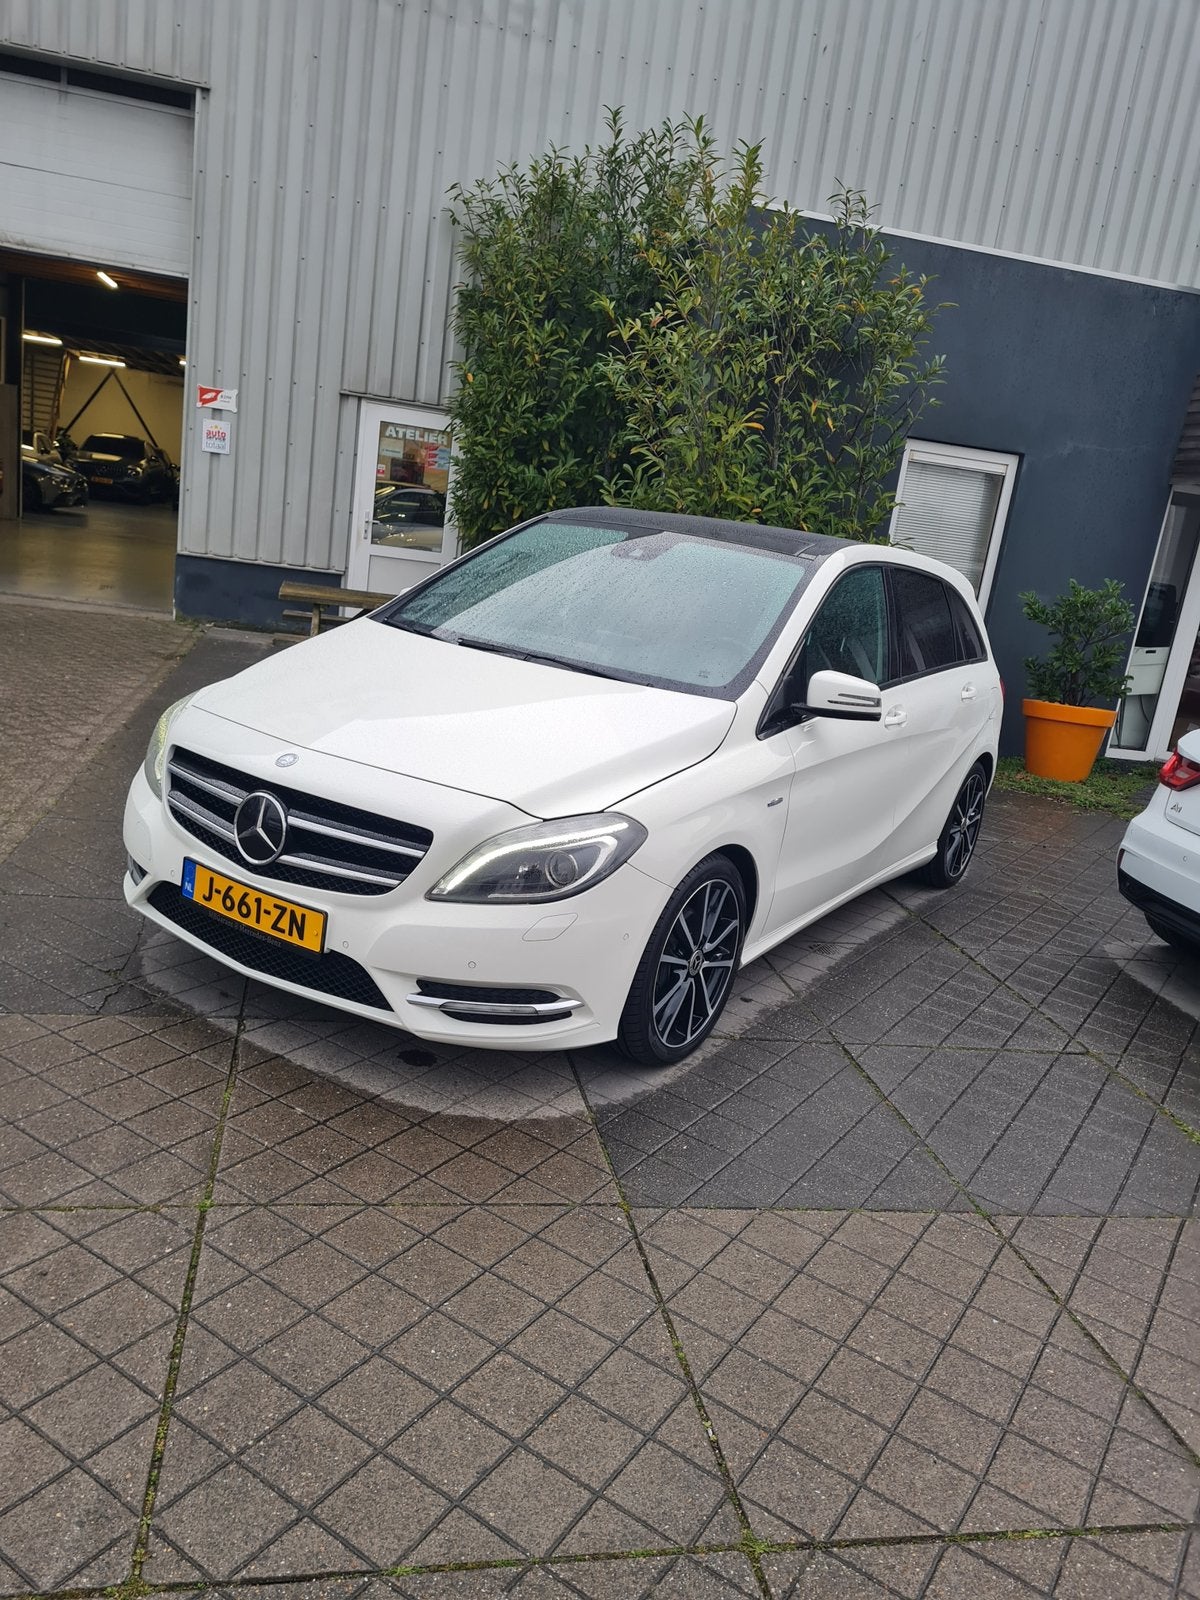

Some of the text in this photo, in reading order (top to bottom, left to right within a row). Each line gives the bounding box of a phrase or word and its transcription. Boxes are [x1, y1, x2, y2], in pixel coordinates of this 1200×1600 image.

[206, 430, 226, 438] auto
[385, 425, 448, 446] ATELIER
[184, 881, 193, 893] NL
[202, 876, 307, 941] J-661-ZN
